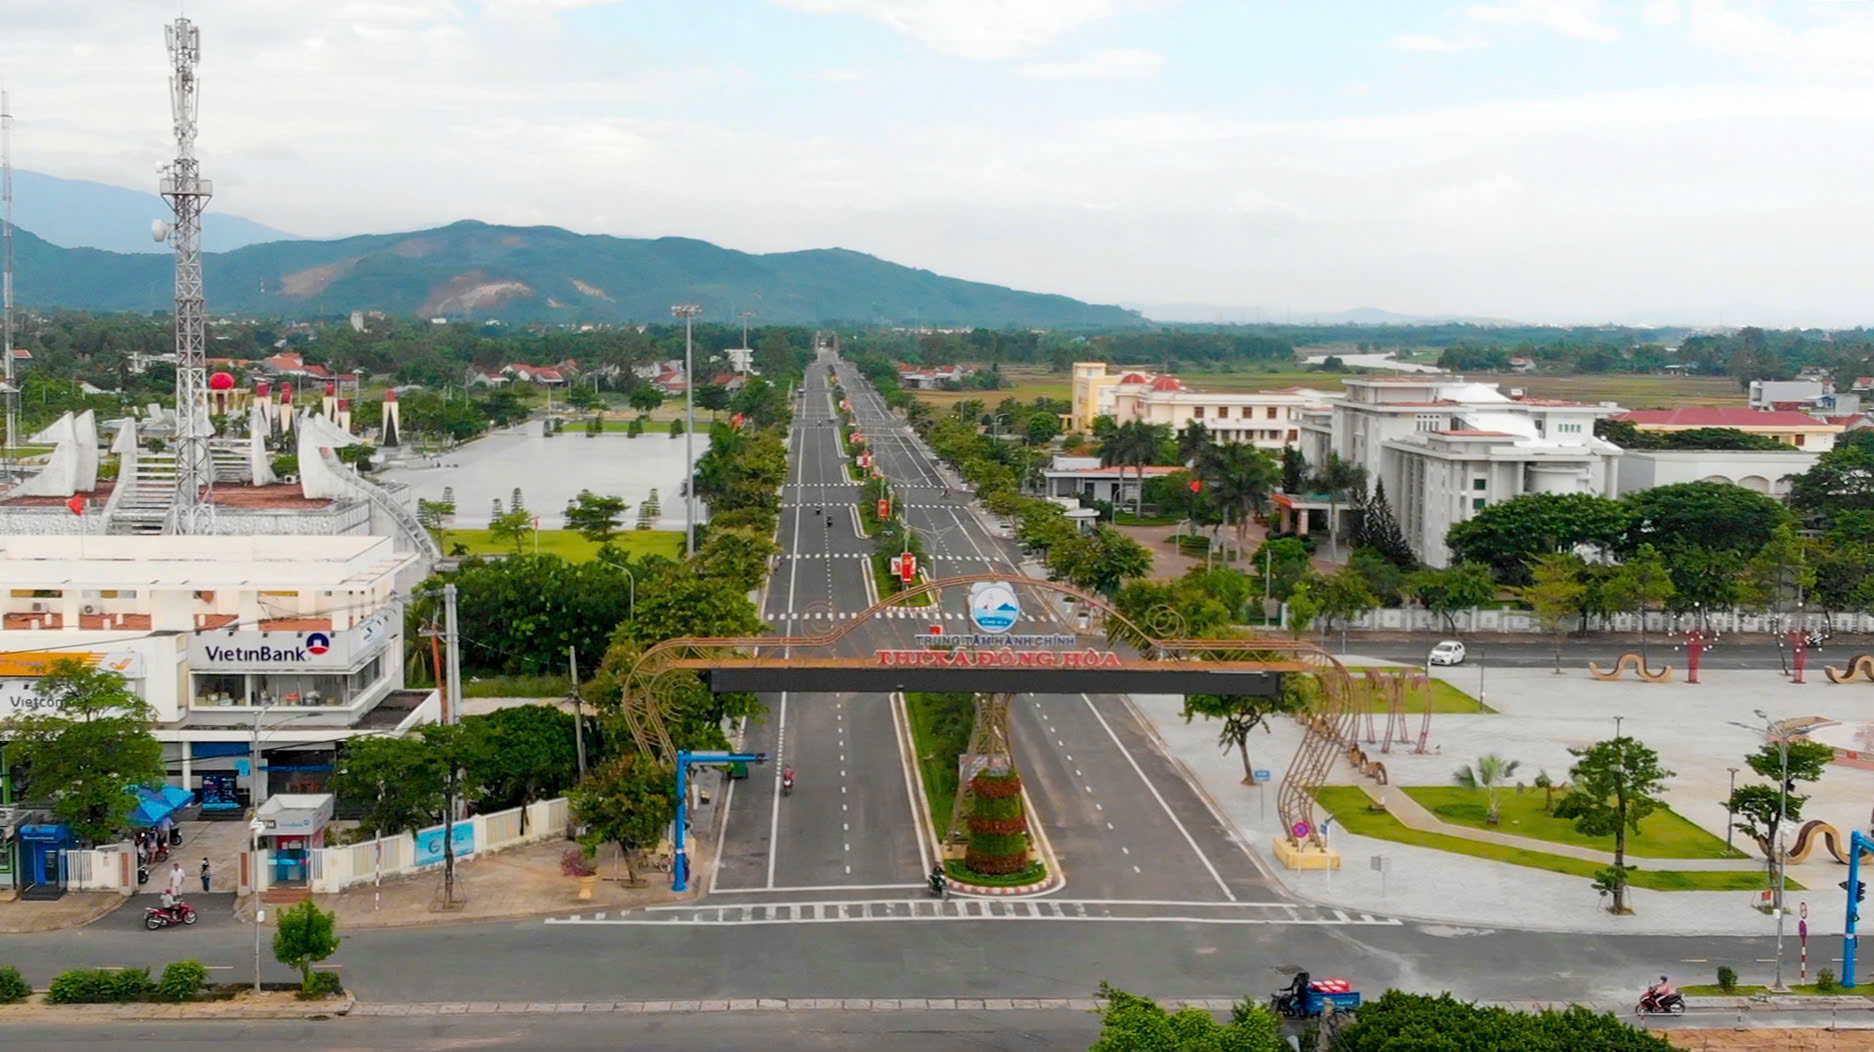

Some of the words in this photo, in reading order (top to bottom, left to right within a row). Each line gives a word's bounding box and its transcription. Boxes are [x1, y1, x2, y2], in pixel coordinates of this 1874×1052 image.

[915, 634, 960, 646] TRUNG
[964, 632, 992, 646] TÂM
[993, 632, 1033, 646] HÀNH
[1034, 632, 1076, 646] CHÍNH
[205, 645, 306, 662] VietinBank
[977, 647, 1056, 666] ĐÔNG
[1063, 647, 1121, 666] HÒA
